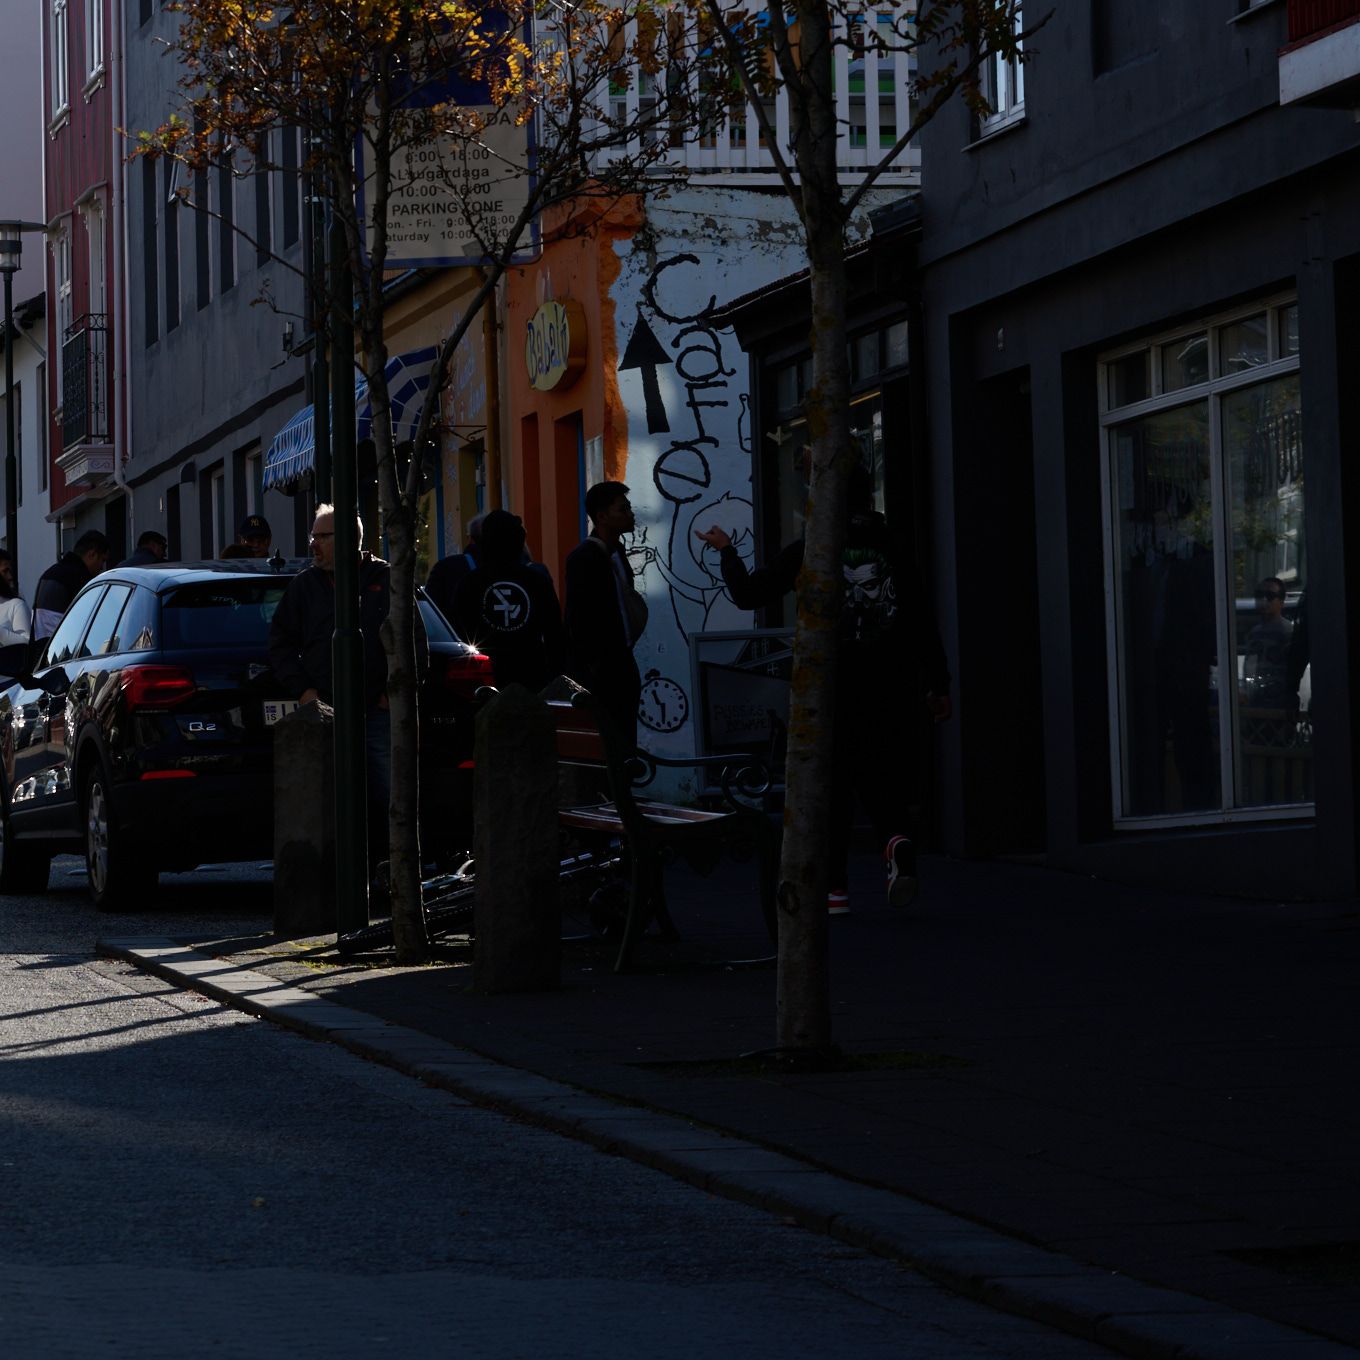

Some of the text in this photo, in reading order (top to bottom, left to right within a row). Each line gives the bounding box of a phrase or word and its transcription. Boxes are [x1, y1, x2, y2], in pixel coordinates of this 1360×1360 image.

[392, 200, 504, 217] PARKING ZONE
[386, 218, 404, 229] on.
[386, 231, 430, 243] aturday
[188, 721, 217, 733] Q2
